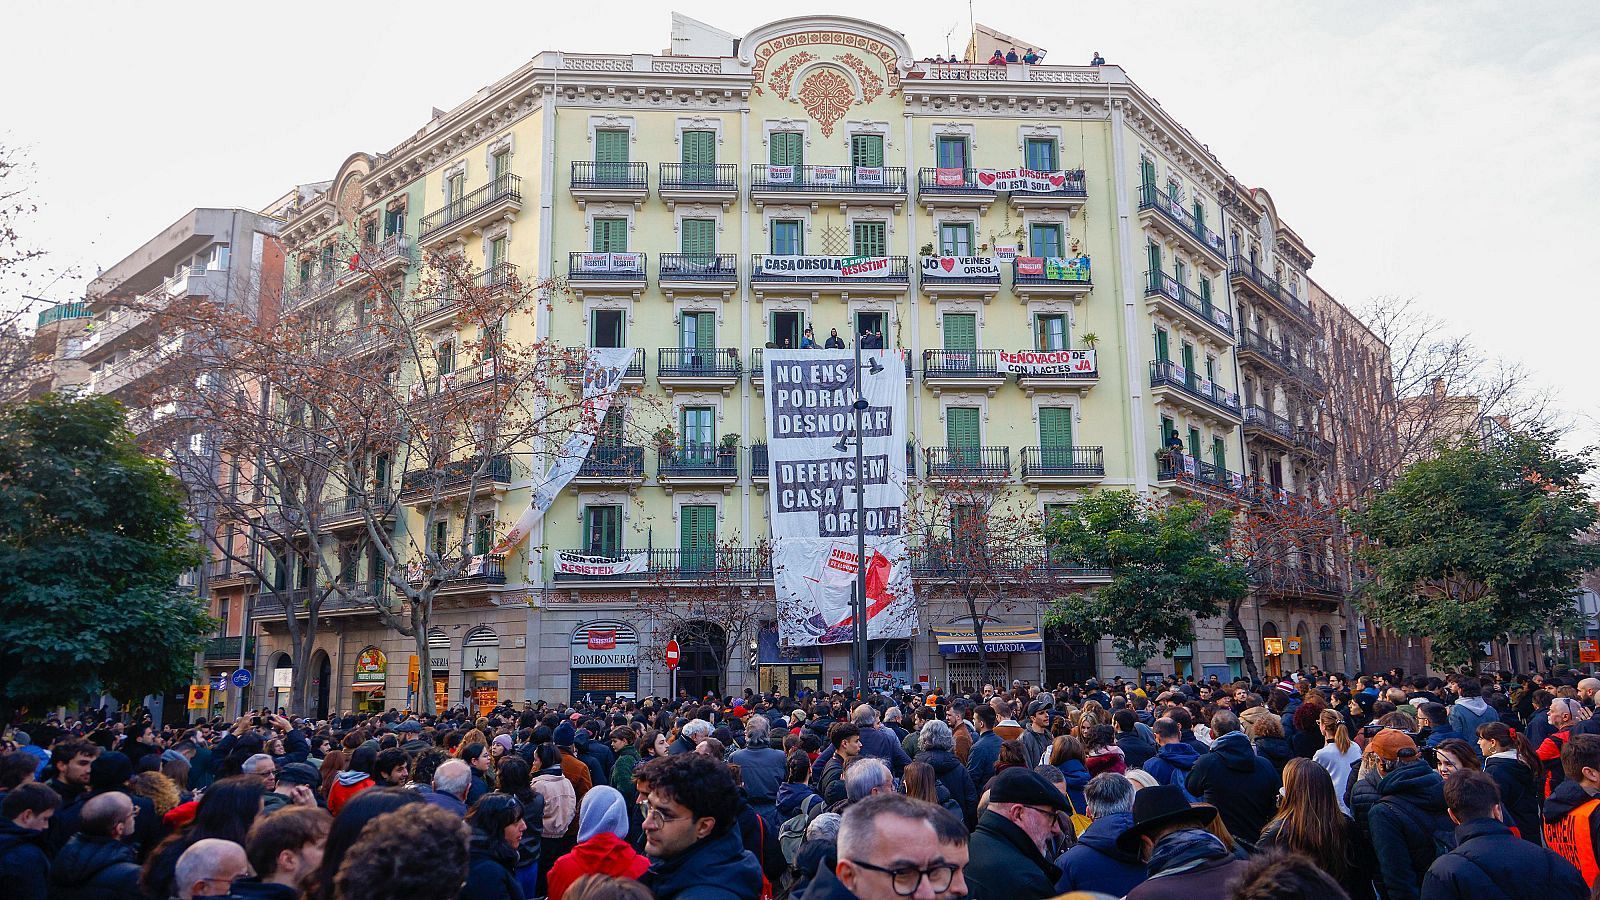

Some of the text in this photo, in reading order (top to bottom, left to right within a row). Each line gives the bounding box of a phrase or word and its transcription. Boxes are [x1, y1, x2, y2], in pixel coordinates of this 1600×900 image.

[996, 169, 1050, 179] CASA ORSOLA
[996, 181, 1007, 190] NO
[1031, 182, 1050, 190] SOLA
[764, 258, 841, 271] CASA ORSOLA
[841, 258, 888, 276] RESISTINT
[922, 258, 938, 269] JO
[964, 265, 999, 274] ORSOLA
[1072, 352, 1086, 360] DE
[1075, 359, 1092, 371] JA
[776, 364, 847, 384] NO ENS
[778, 387, 859, 408] PODRAN
[778, 411, 887, 434] DESNONAR
[782, 487, 837, 509] CASA
[560, 552, 586, 563] CASA
[831, 548, 872, 565] SINDICT
[561, 563, 614, 575] RESISTEIX
[967, 643, 1027, 654] VAGUARDIA
